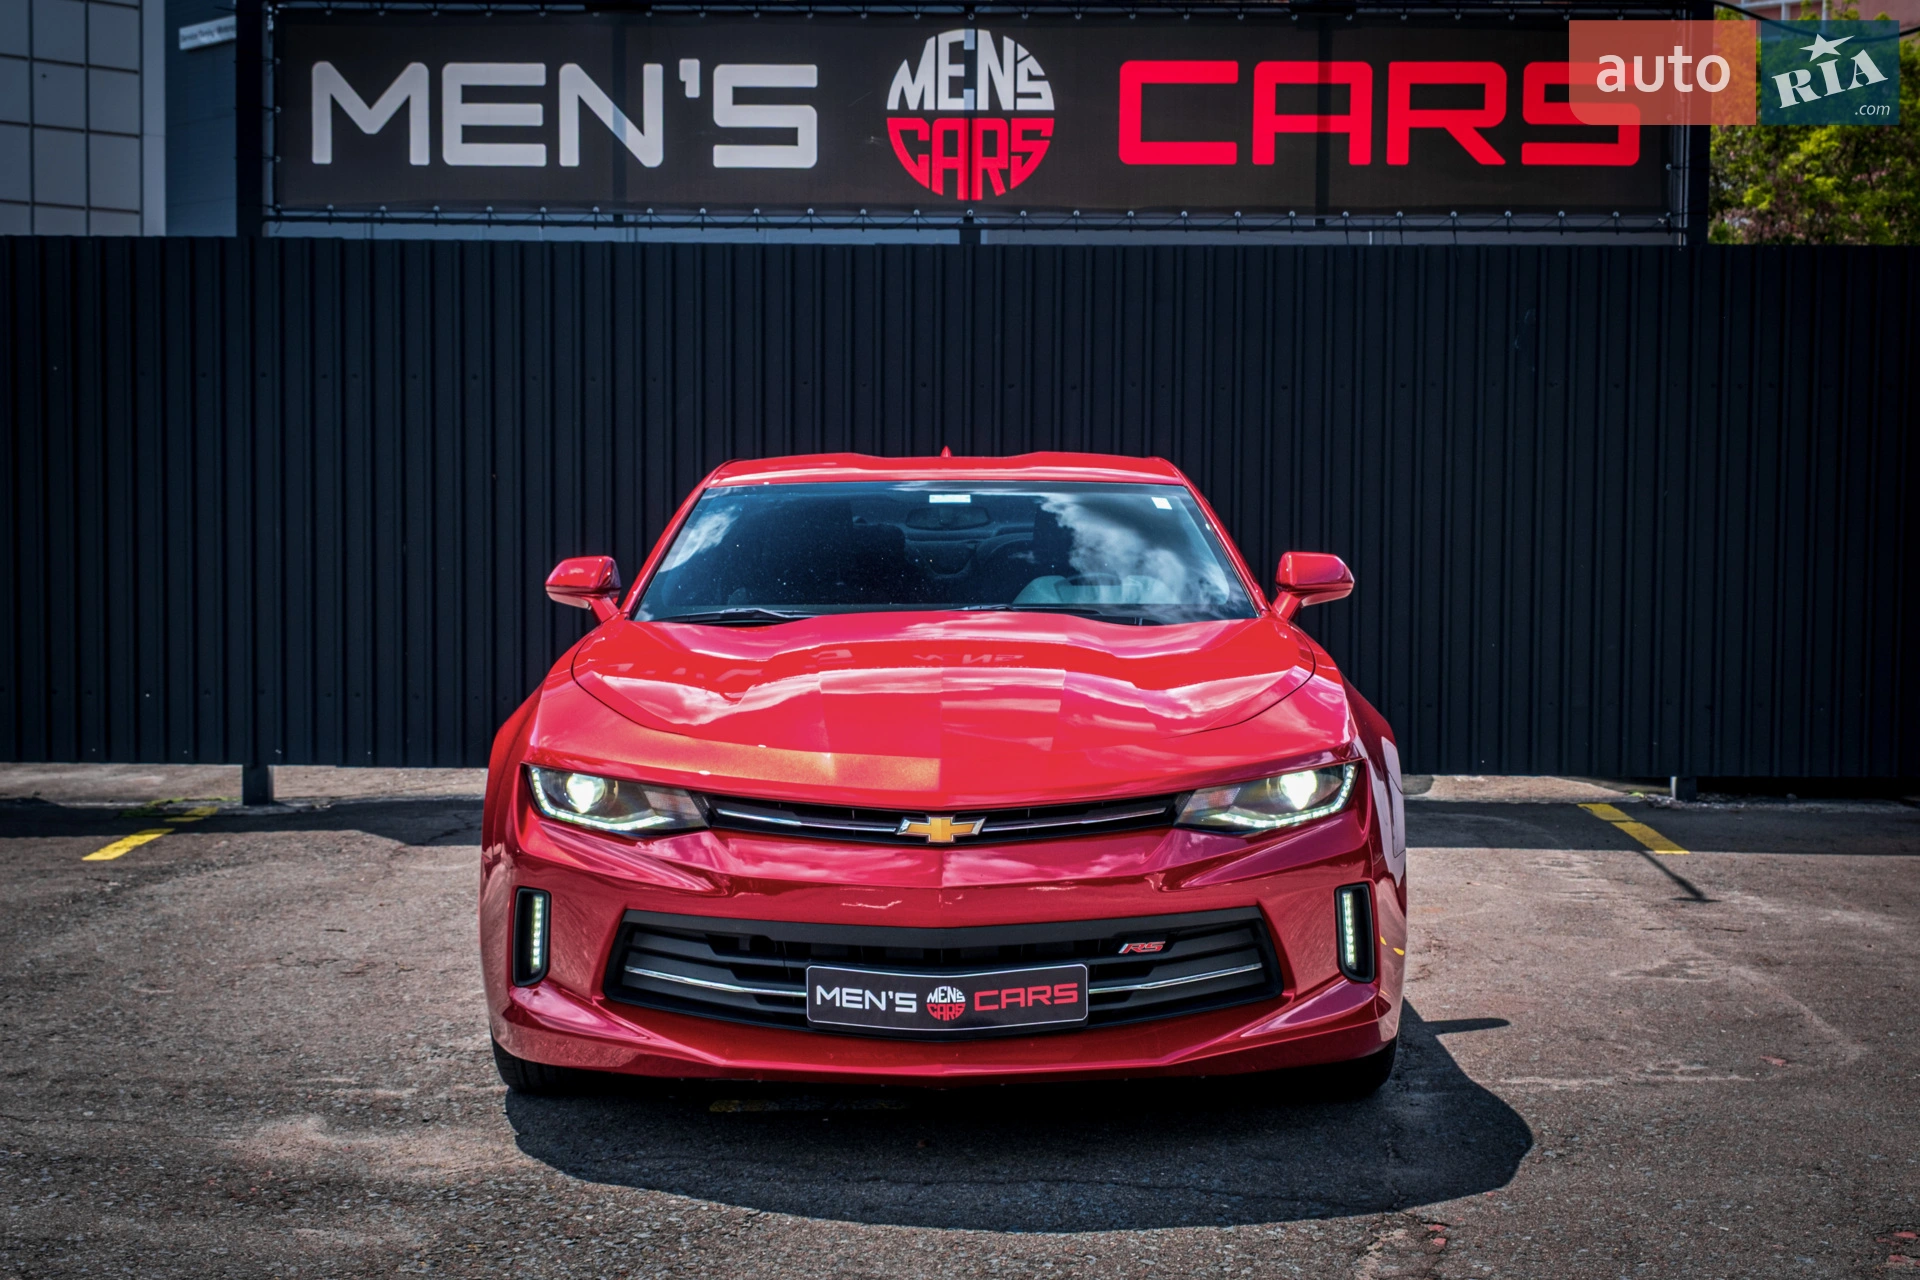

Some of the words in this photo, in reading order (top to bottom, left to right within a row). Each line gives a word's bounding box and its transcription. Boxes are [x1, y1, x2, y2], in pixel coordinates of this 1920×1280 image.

[886, 28, 1055, 111] MEN'S
[312, 58, 818, 168] MEN'S
[1118, 59, 1641, 167] CARS
[886, 117, 1055, 200] CARS
[1120, 941, 1166, 954] RS
[815, 984, 918, 1014] MEN'S
[973, 982, 1079, 1012] CARS
[926, 1002, 966, 1022] CARS
